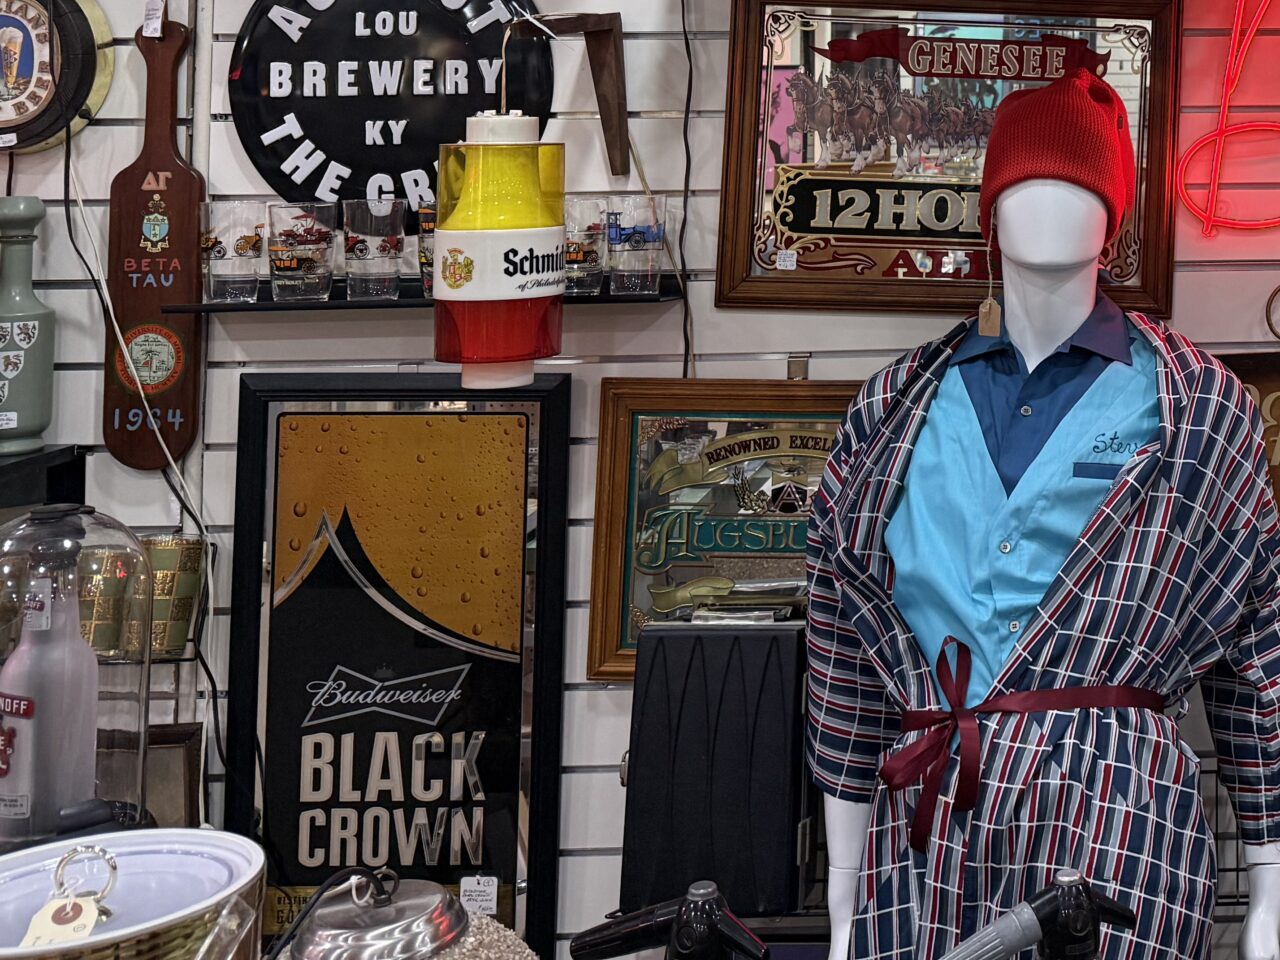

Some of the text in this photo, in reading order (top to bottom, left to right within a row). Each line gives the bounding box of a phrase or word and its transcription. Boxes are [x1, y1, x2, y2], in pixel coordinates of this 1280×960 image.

[355, 11, 418, 37] LOU
[907, 40, 1067, 77] GENESEE
[269, 58, 503, 98] BREWERY
[365, 120, 409, 145] KY
[260, 113, 352, 202] THE
[809, 188, 872, 230] 12
[123, 257, 182, 272] BETA
[128, 272, 174, 288] TAU
[705, 435, 832, 465] RENOWNED EXCEL
[1092, 431, 1138, 454] Stev
[306, 680, 462, 708] Budweiser
[299, 730, 486, 802] BLACK
[298, 806, 485, 868] CROWN
